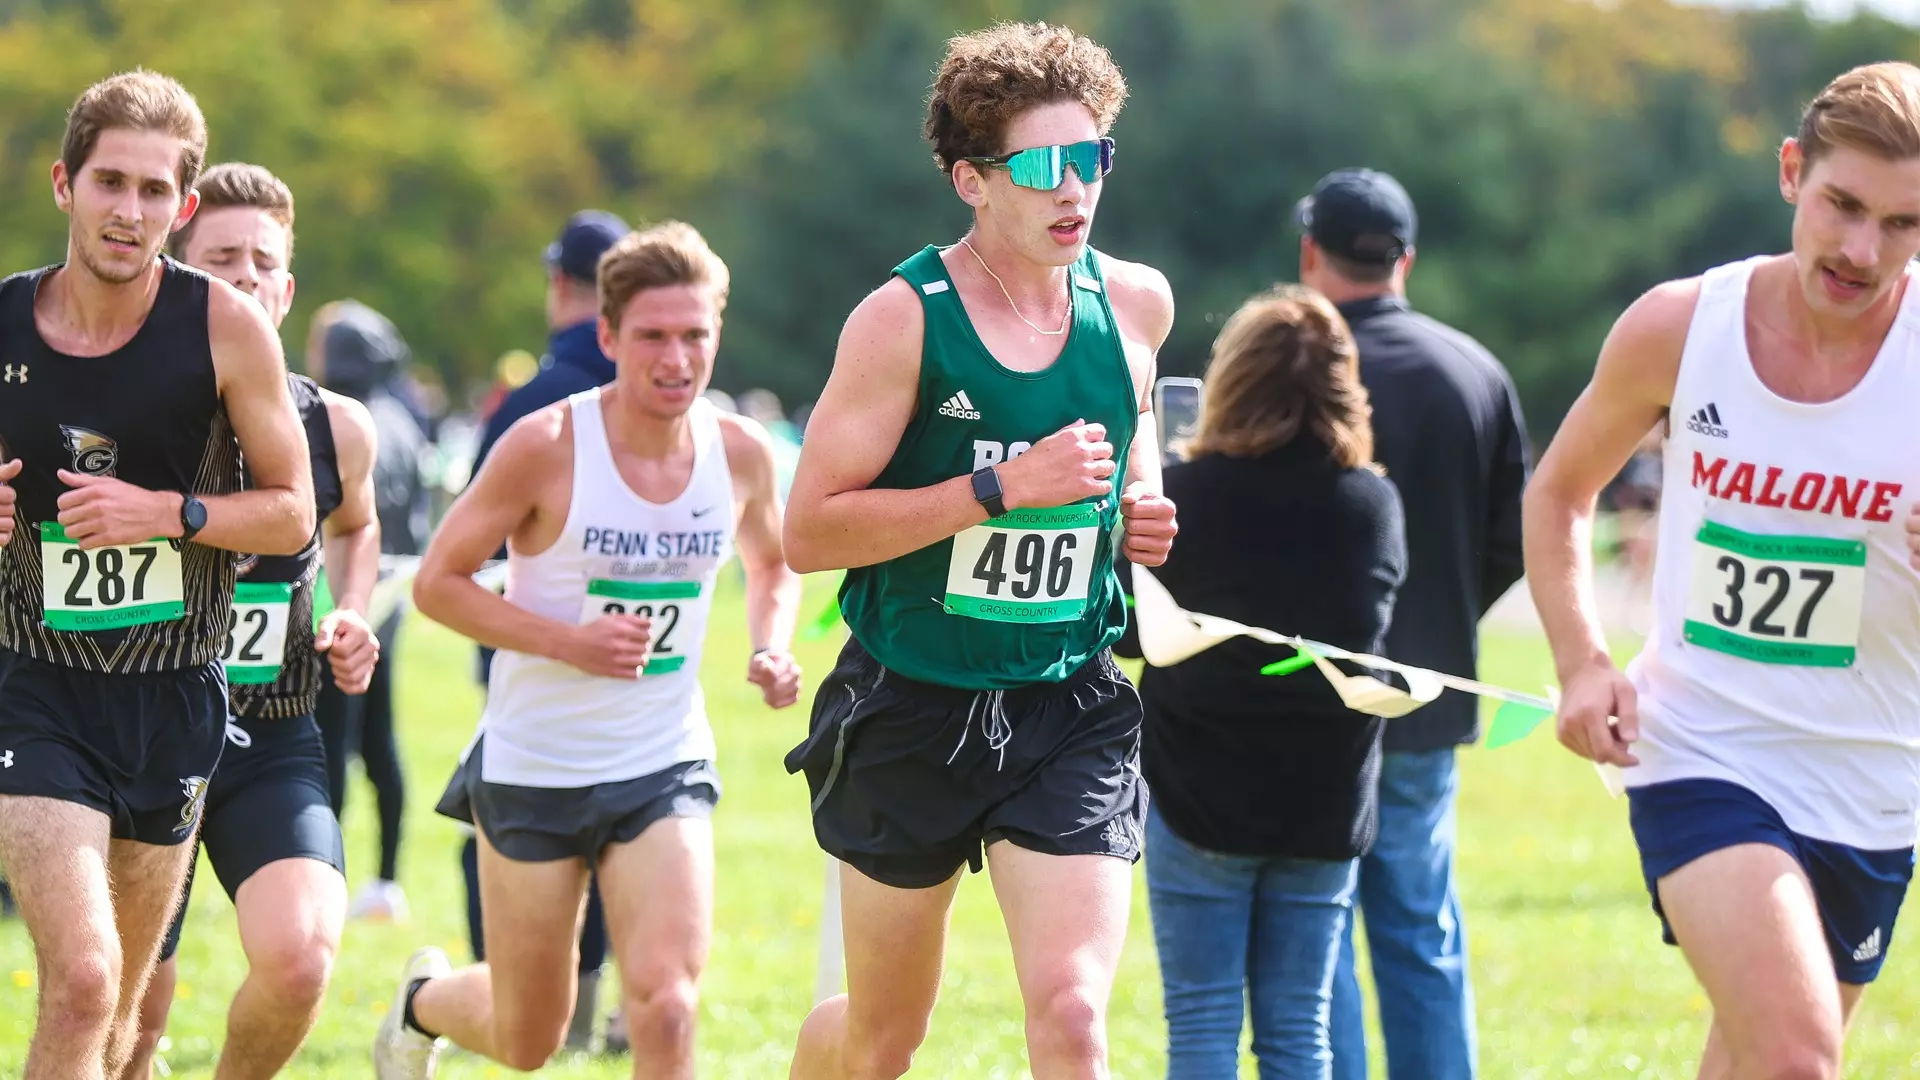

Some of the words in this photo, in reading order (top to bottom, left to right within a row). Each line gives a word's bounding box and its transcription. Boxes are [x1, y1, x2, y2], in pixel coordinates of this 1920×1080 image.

[938, 407, 981, 420] adidas
[1686, 421, 1729, 439] adidas
[1691, 450, 1903, 523] MALONE
[1016, 513, 1042, 524] ROCK
[1044, 512, 1093, 524] UNIVERSITY
[583, 527, 647, 556] PENN
[656, 529, 724, 558] STATE
[62, 546, 158, 607] 287
[972, 531, 1077, 599] 496
[1712, 555, 1835, 639] 327
[75, 614, 105, 626] CROSS
[107, 608, 152, 622] COUNTRY
[979, 604, 1013, 616] CROSS
[1015, 606, 1059, 617] COUNTRY
